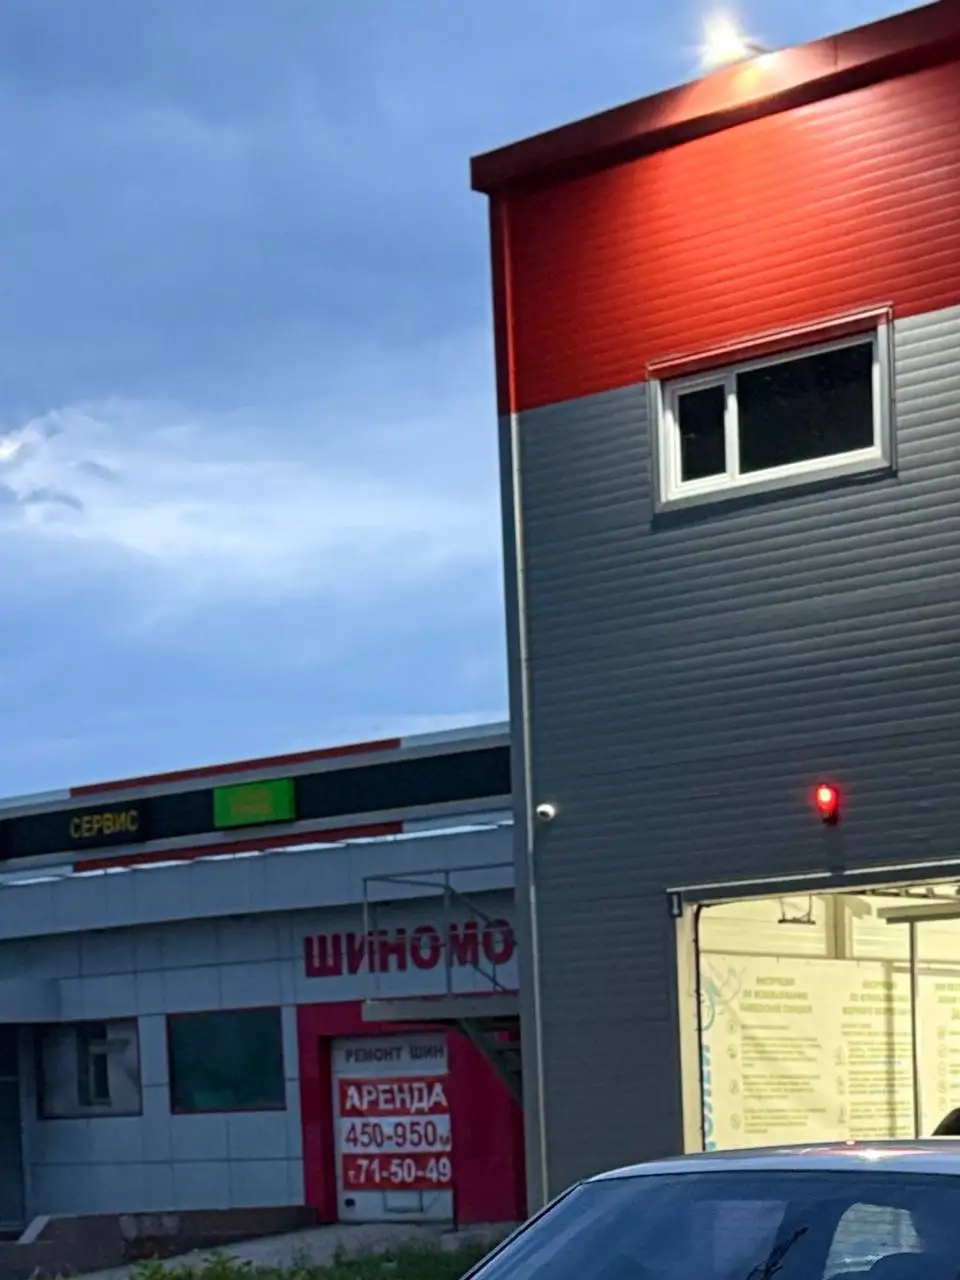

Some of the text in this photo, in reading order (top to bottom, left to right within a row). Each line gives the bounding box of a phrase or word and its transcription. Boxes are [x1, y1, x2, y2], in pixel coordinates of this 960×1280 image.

[70, 810, 139, 838] СЕРВИС
[346, 1044, 444, 1062] РЕМОНТ ШИН
[345, 1082, 449, 1113] АРЕНДА
